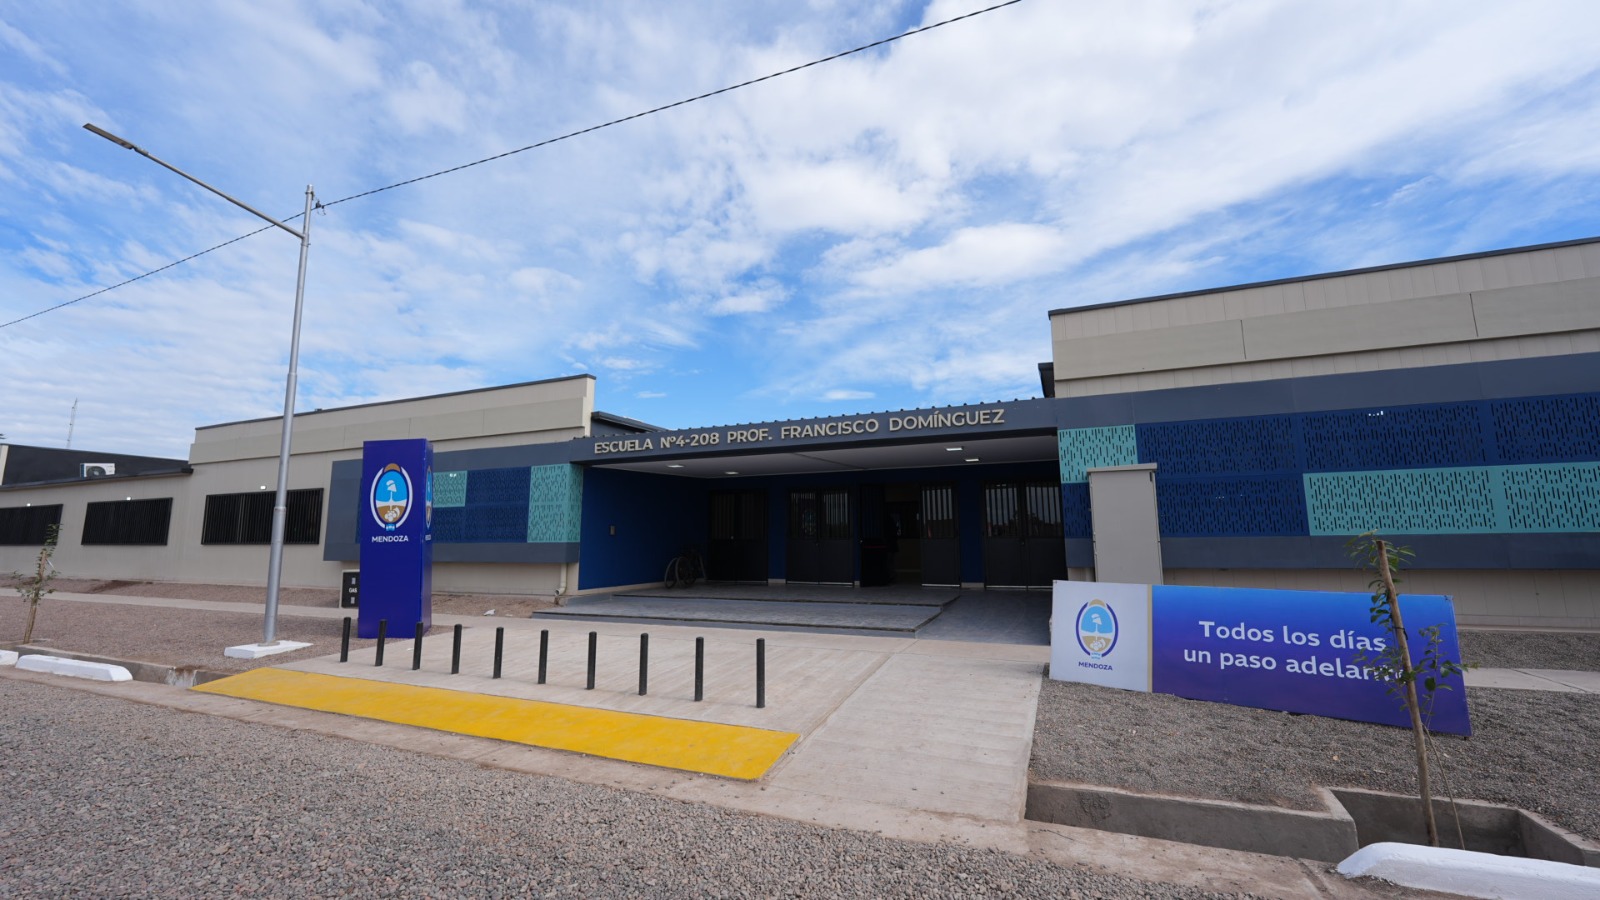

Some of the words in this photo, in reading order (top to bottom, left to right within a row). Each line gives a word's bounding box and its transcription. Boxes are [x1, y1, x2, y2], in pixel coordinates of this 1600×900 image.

[594, 438, 654, 454] ESCUELA
[727, 428, 773, 444] PROF.
[780, 418, 879, 440] FRANCISCO
[889, 410, 1005, 432] DOMÍNGUEZ
[371, 535, 409, 543] MENDOZA
[1199, 620, 1275, 643] Todos
[1283, 625, 1320, 647] los
[1329, 629, 1387, 652] días
[1078, 661, 1113, 671] MENDOZA
[1184, 648, 1212, 664] un
[1220, 652, 1277, 669] paso
